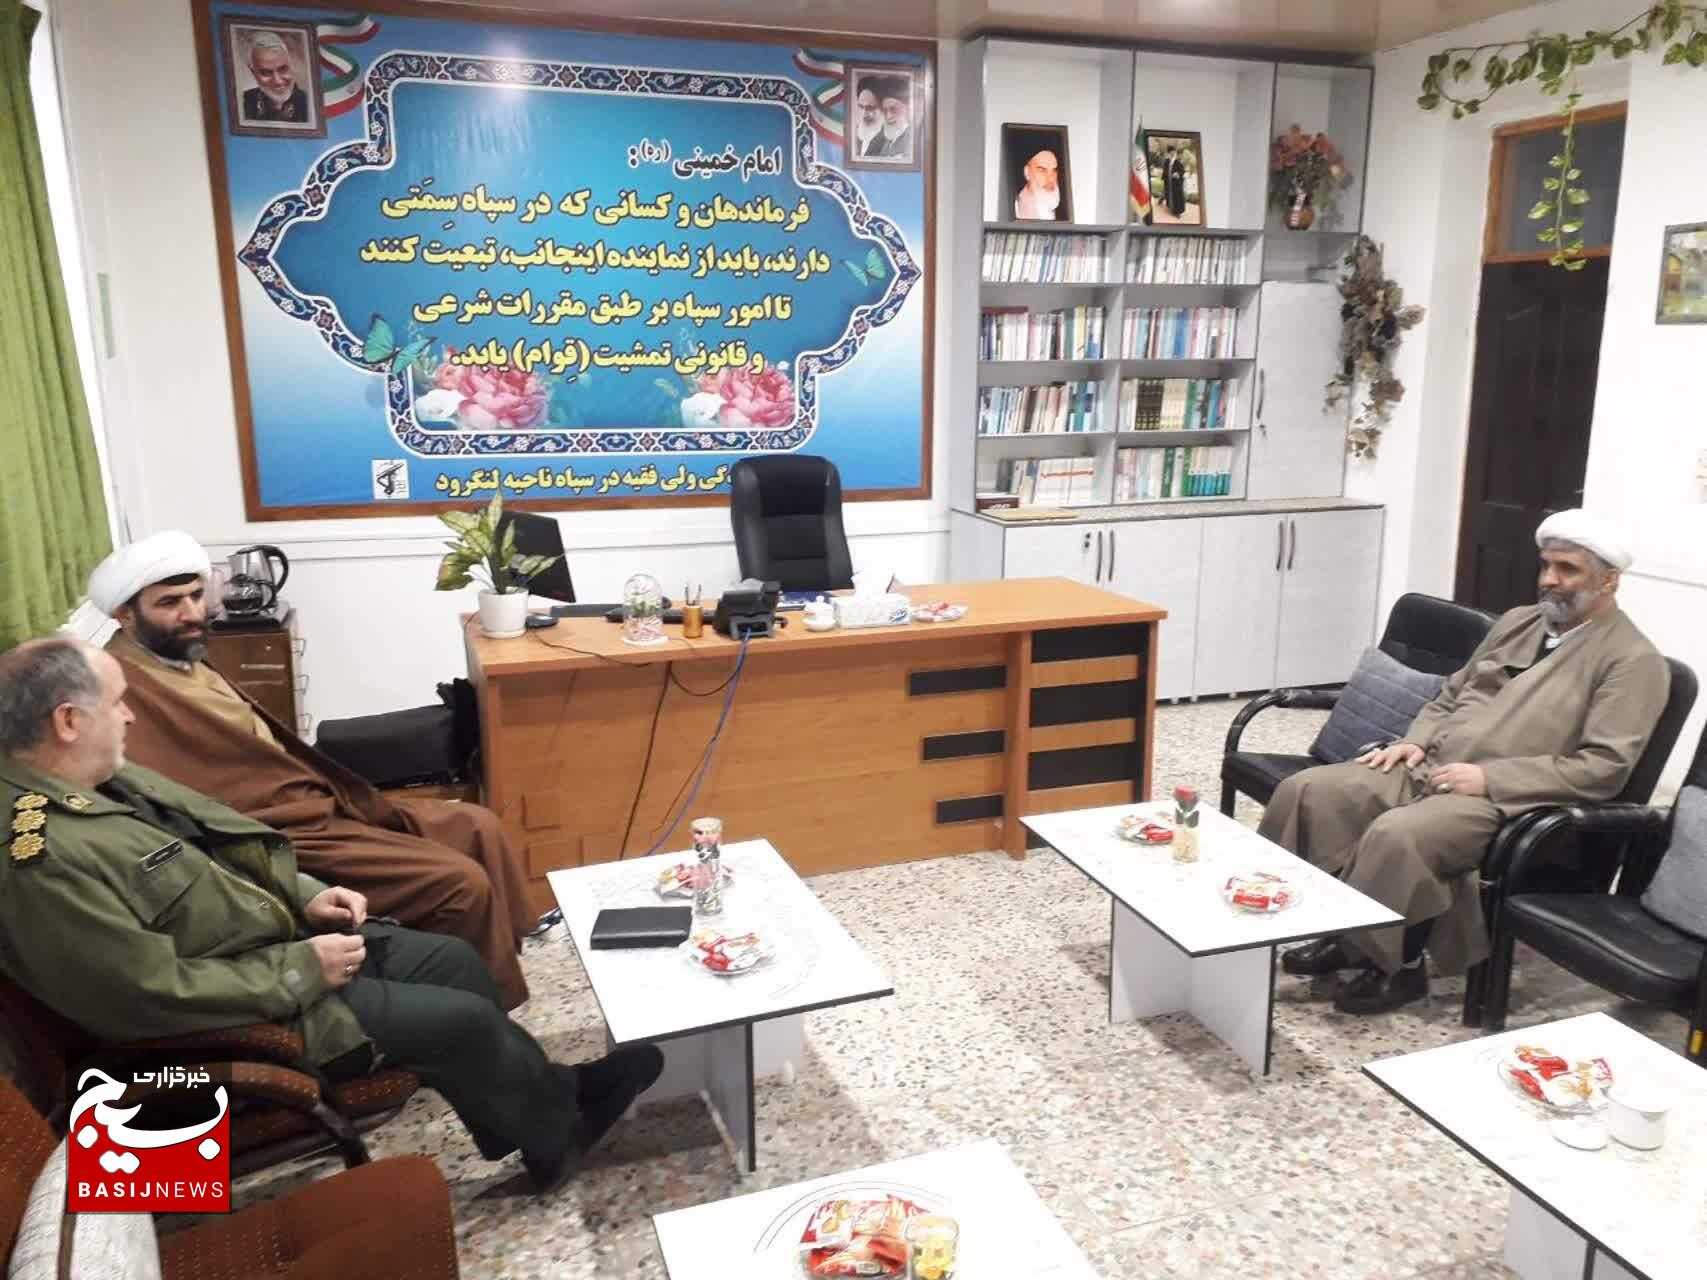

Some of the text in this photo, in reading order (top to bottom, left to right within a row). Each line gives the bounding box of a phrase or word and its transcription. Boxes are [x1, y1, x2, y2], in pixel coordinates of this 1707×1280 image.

[673, 144, 739, 179] خمینی
[740, 147, 782, 181] امام
[461, 184, 517, 223] سپاه
[519, 192, 553, 224] در
[559, 189, 591, 216] که
[594, 191, 673, 226] کسانی
[675, 202, 691, 228] و
[693, 194, 812, 232] فرماندهان
[360, 235, 831, 281] دارند، باید از نماینده اینجانب، تبعیت کنند
[413, 288, 793, 328] تا امور سپاه بر طبق مقررات شرعی
[450, 338, 509, 374] یابد.
[593, 340, 672, 373] تمشیت
[674, 339, 748, 375] قانونی
[750, 351, 765, 374] و
[435, 468, 500, 497] لنگرود
[502, 466, 553, 495] ناحیه
[555, 466, 596, 495] سپاه
[597, 469, 620, 494] در
[621, 463, 659, 490] فقیه
[660, 464, 697, 491] ولی
